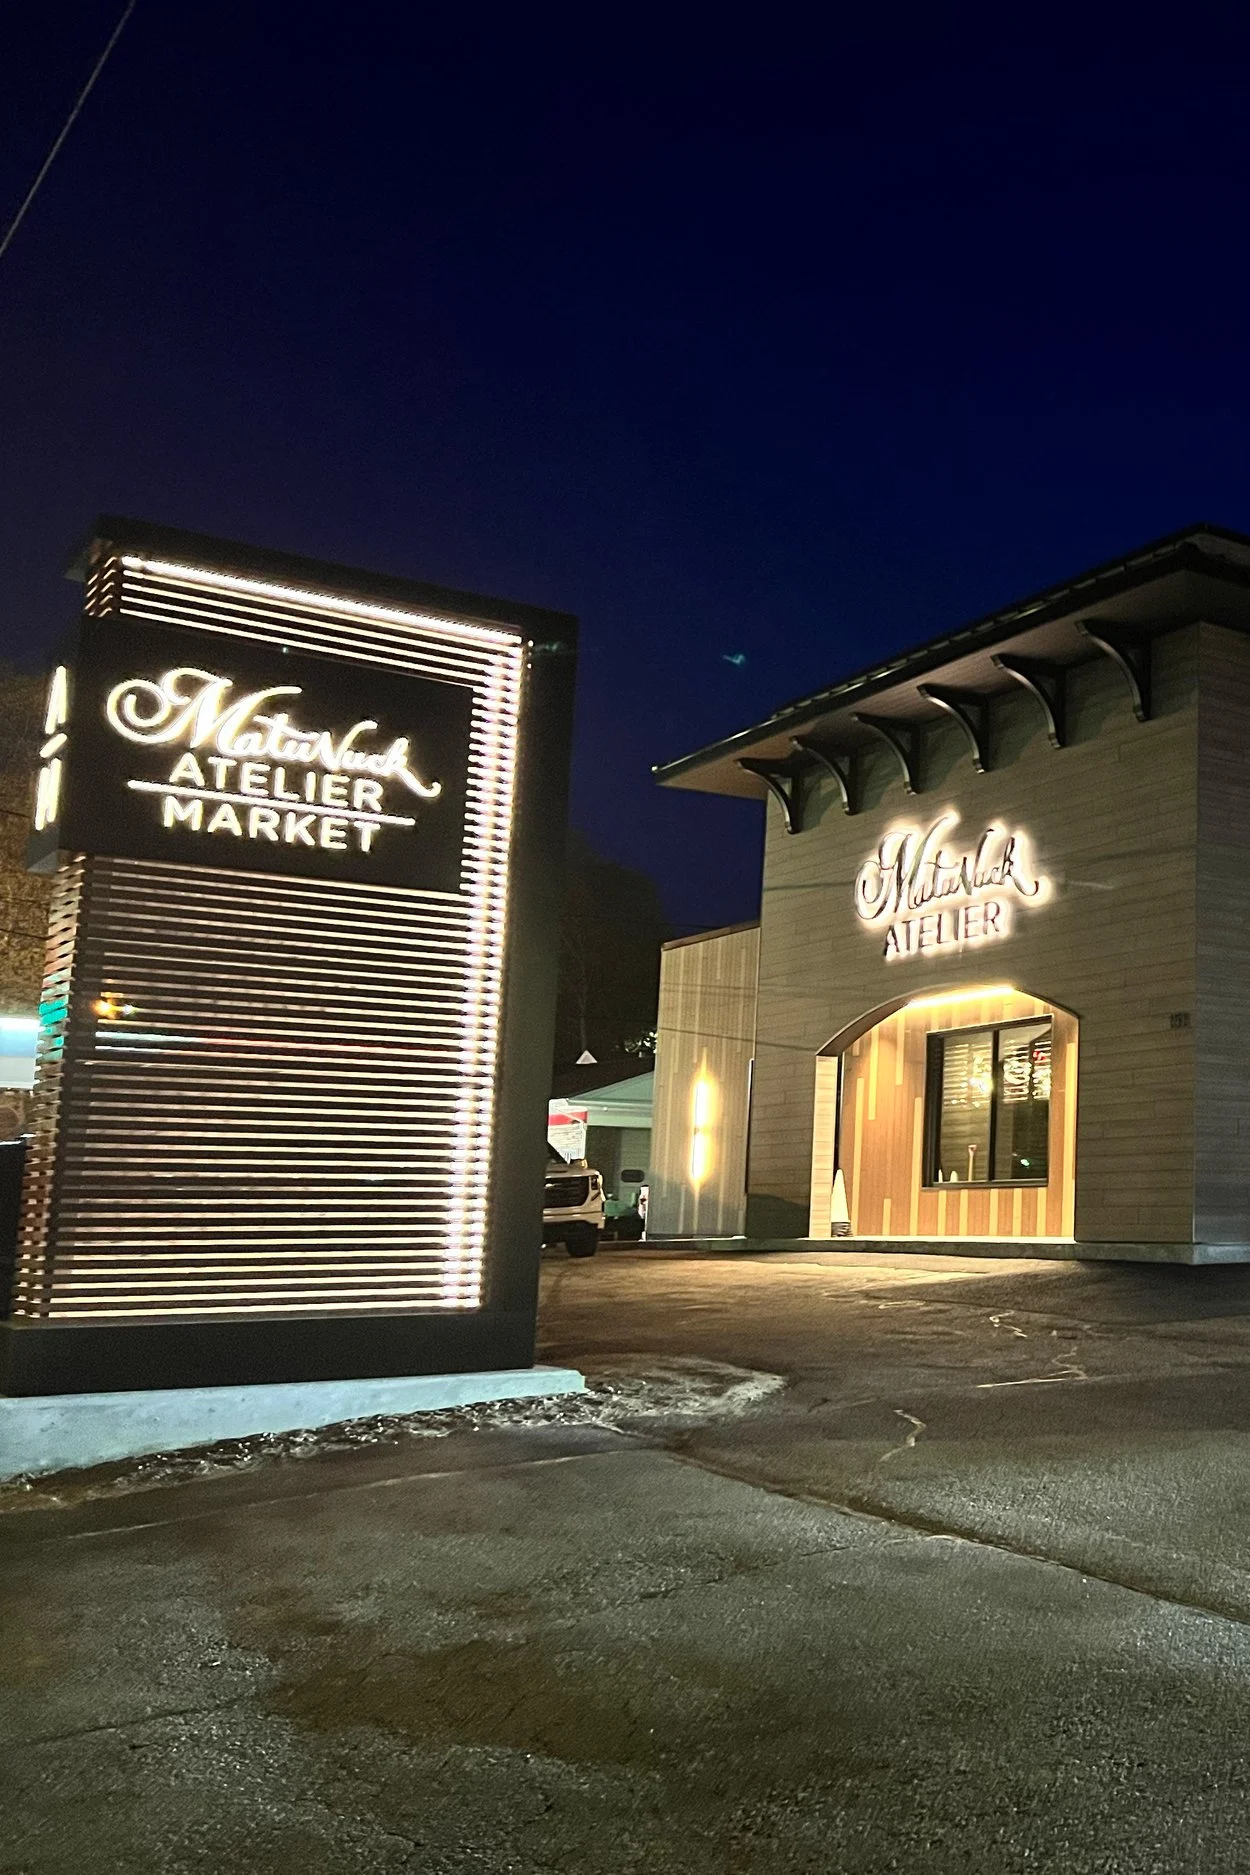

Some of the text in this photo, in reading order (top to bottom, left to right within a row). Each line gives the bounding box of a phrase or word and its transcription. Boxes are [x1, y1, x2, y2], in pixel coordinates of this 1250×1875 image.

[168, 751, 384, 812] ATELIER
[162, 795, 382, 854] MARKET
[883, 901, 1003, 958] ATELIER
